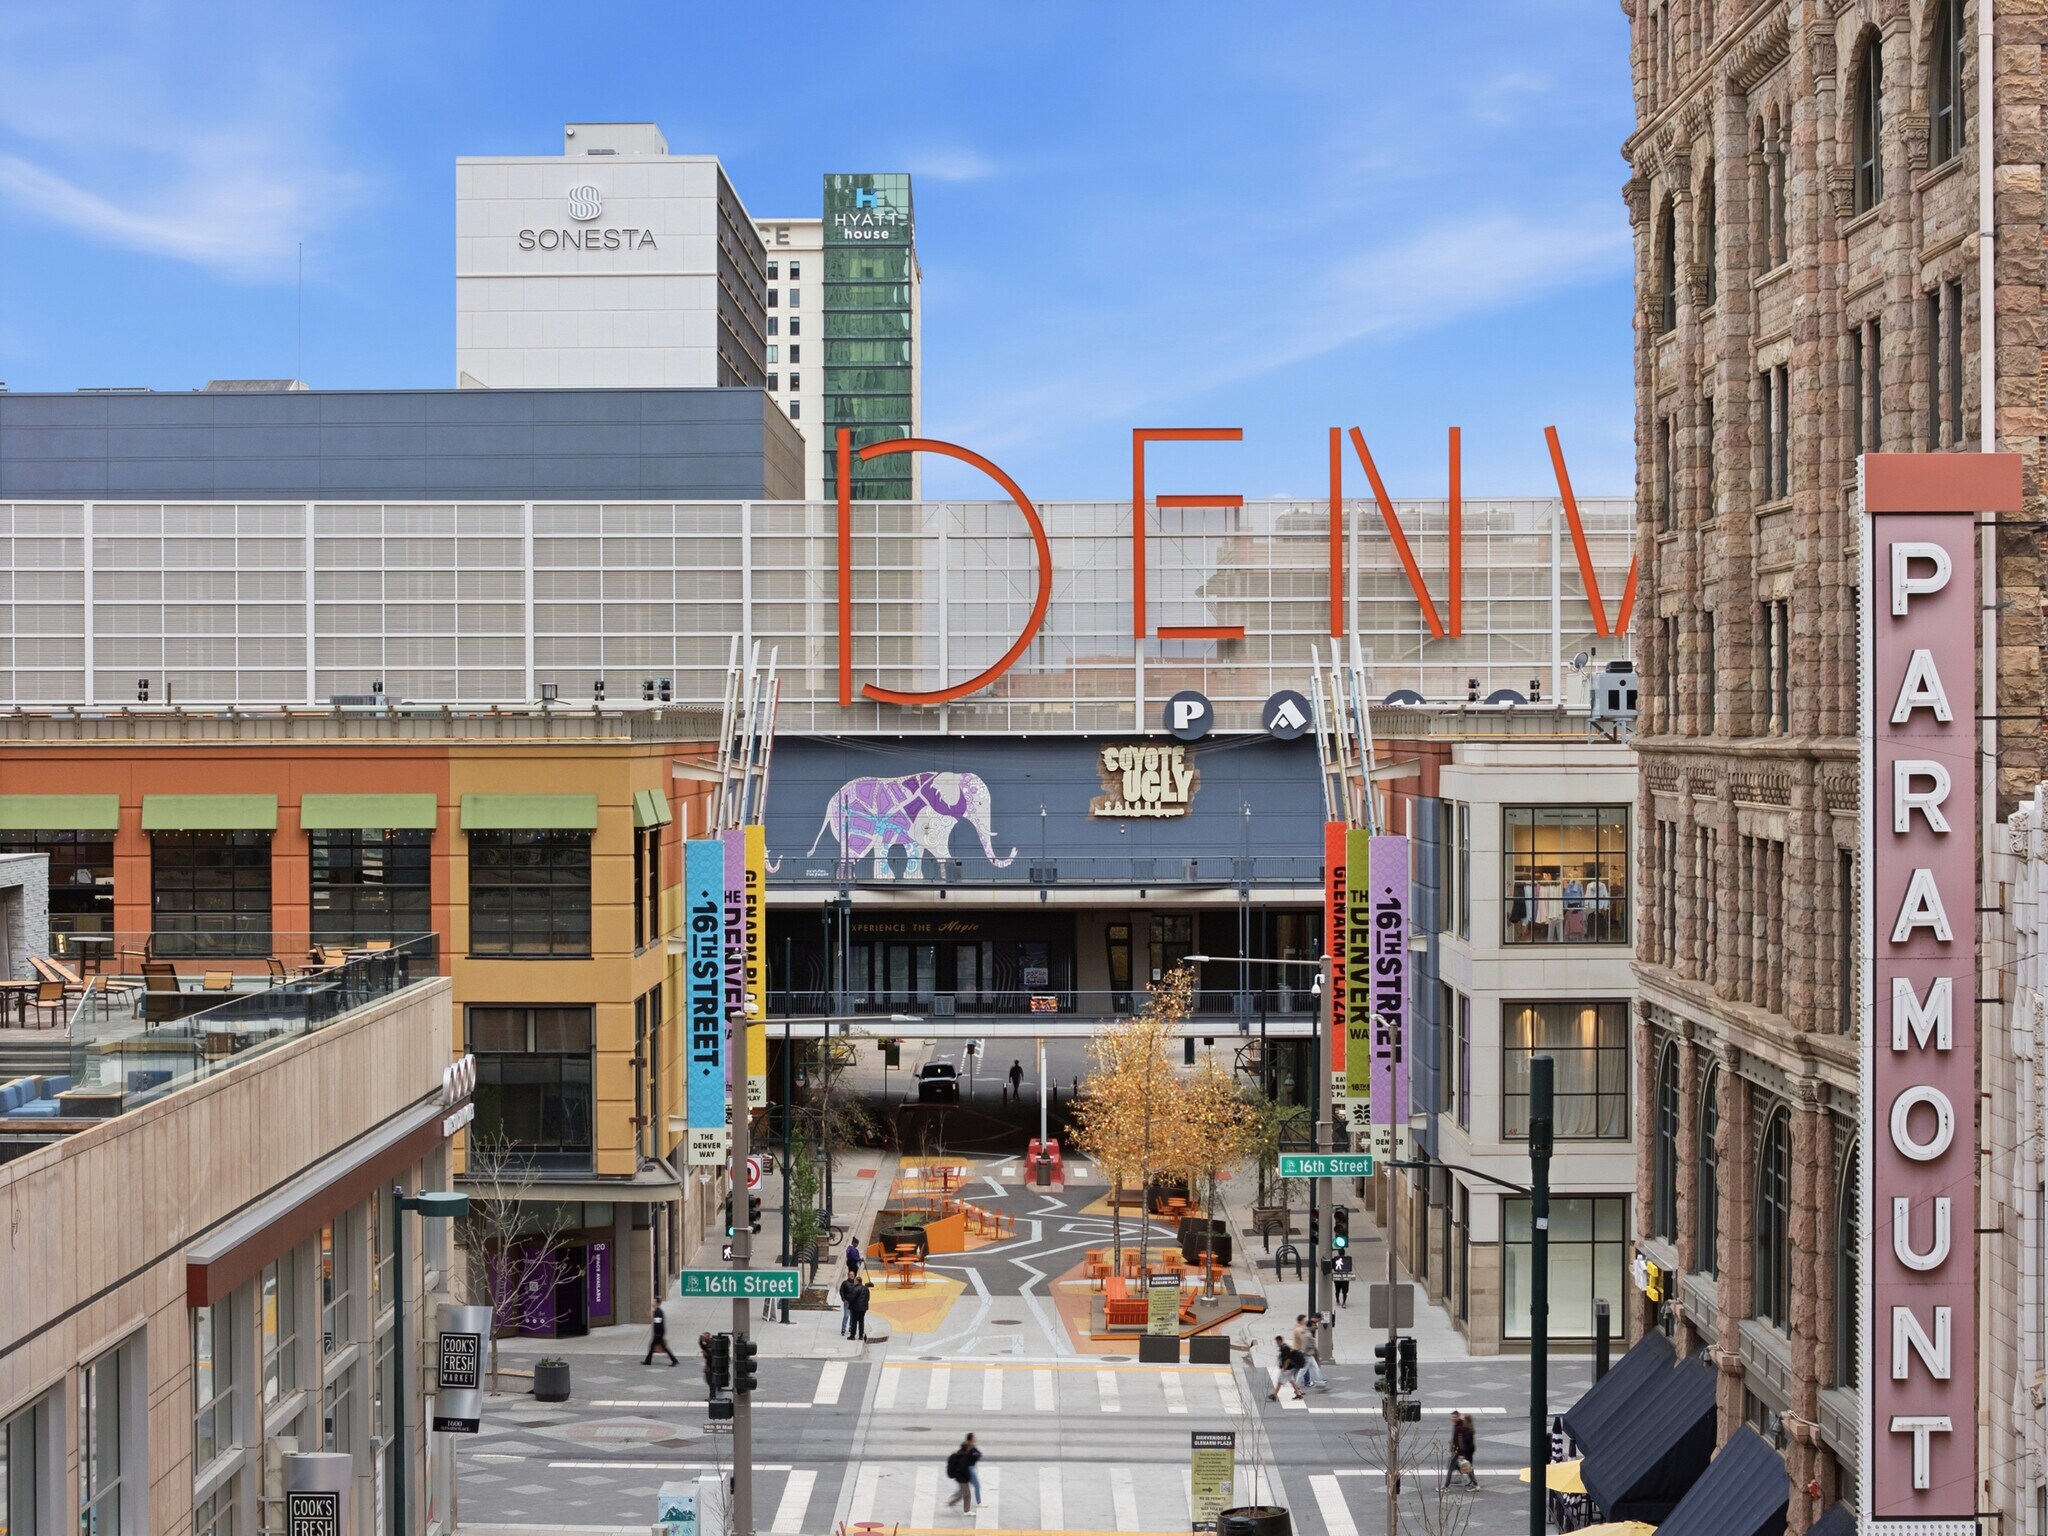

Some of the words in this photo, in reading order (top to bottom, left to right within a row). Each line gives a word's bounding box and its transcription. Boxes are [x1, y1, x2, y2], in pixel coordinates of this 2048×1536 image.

[835, 213, 899, 227] HYATT
[518, 228, 658, 250] SONESTA
[844, 228, 890, 240] house
[1101, 744, 1185, 772] COYOTE
[1122, 768, 1194, 803] UGLY
[724, 890, 741, 903] HE
[1350, 889, 1369, 903] TH
[852, 923, 906, 932] XPERIENCE
[912, 923, 931, 932] THE
[1890, 542, 1955, 1489] PARAMOUNT
[1350, 1028, 1370, 1040] WA
[1299, 1160, 1325, 1173] 16th
[1330, 1159, 1368, 1173] Street
[593, 1243, 606, 1251] 120
[704, 1276, 737, 1292] 16th
[744, 1276, 794, 1293] Street
[443, 1338, 475, 1353] COOK'S
[443, 1355, 474, 1371] FRESH
[442, 1373, 474, 1383] MARKET
[293, 1499, 333, 1516] COOK'S
[294, 1520, 333, 1536] FRESH
